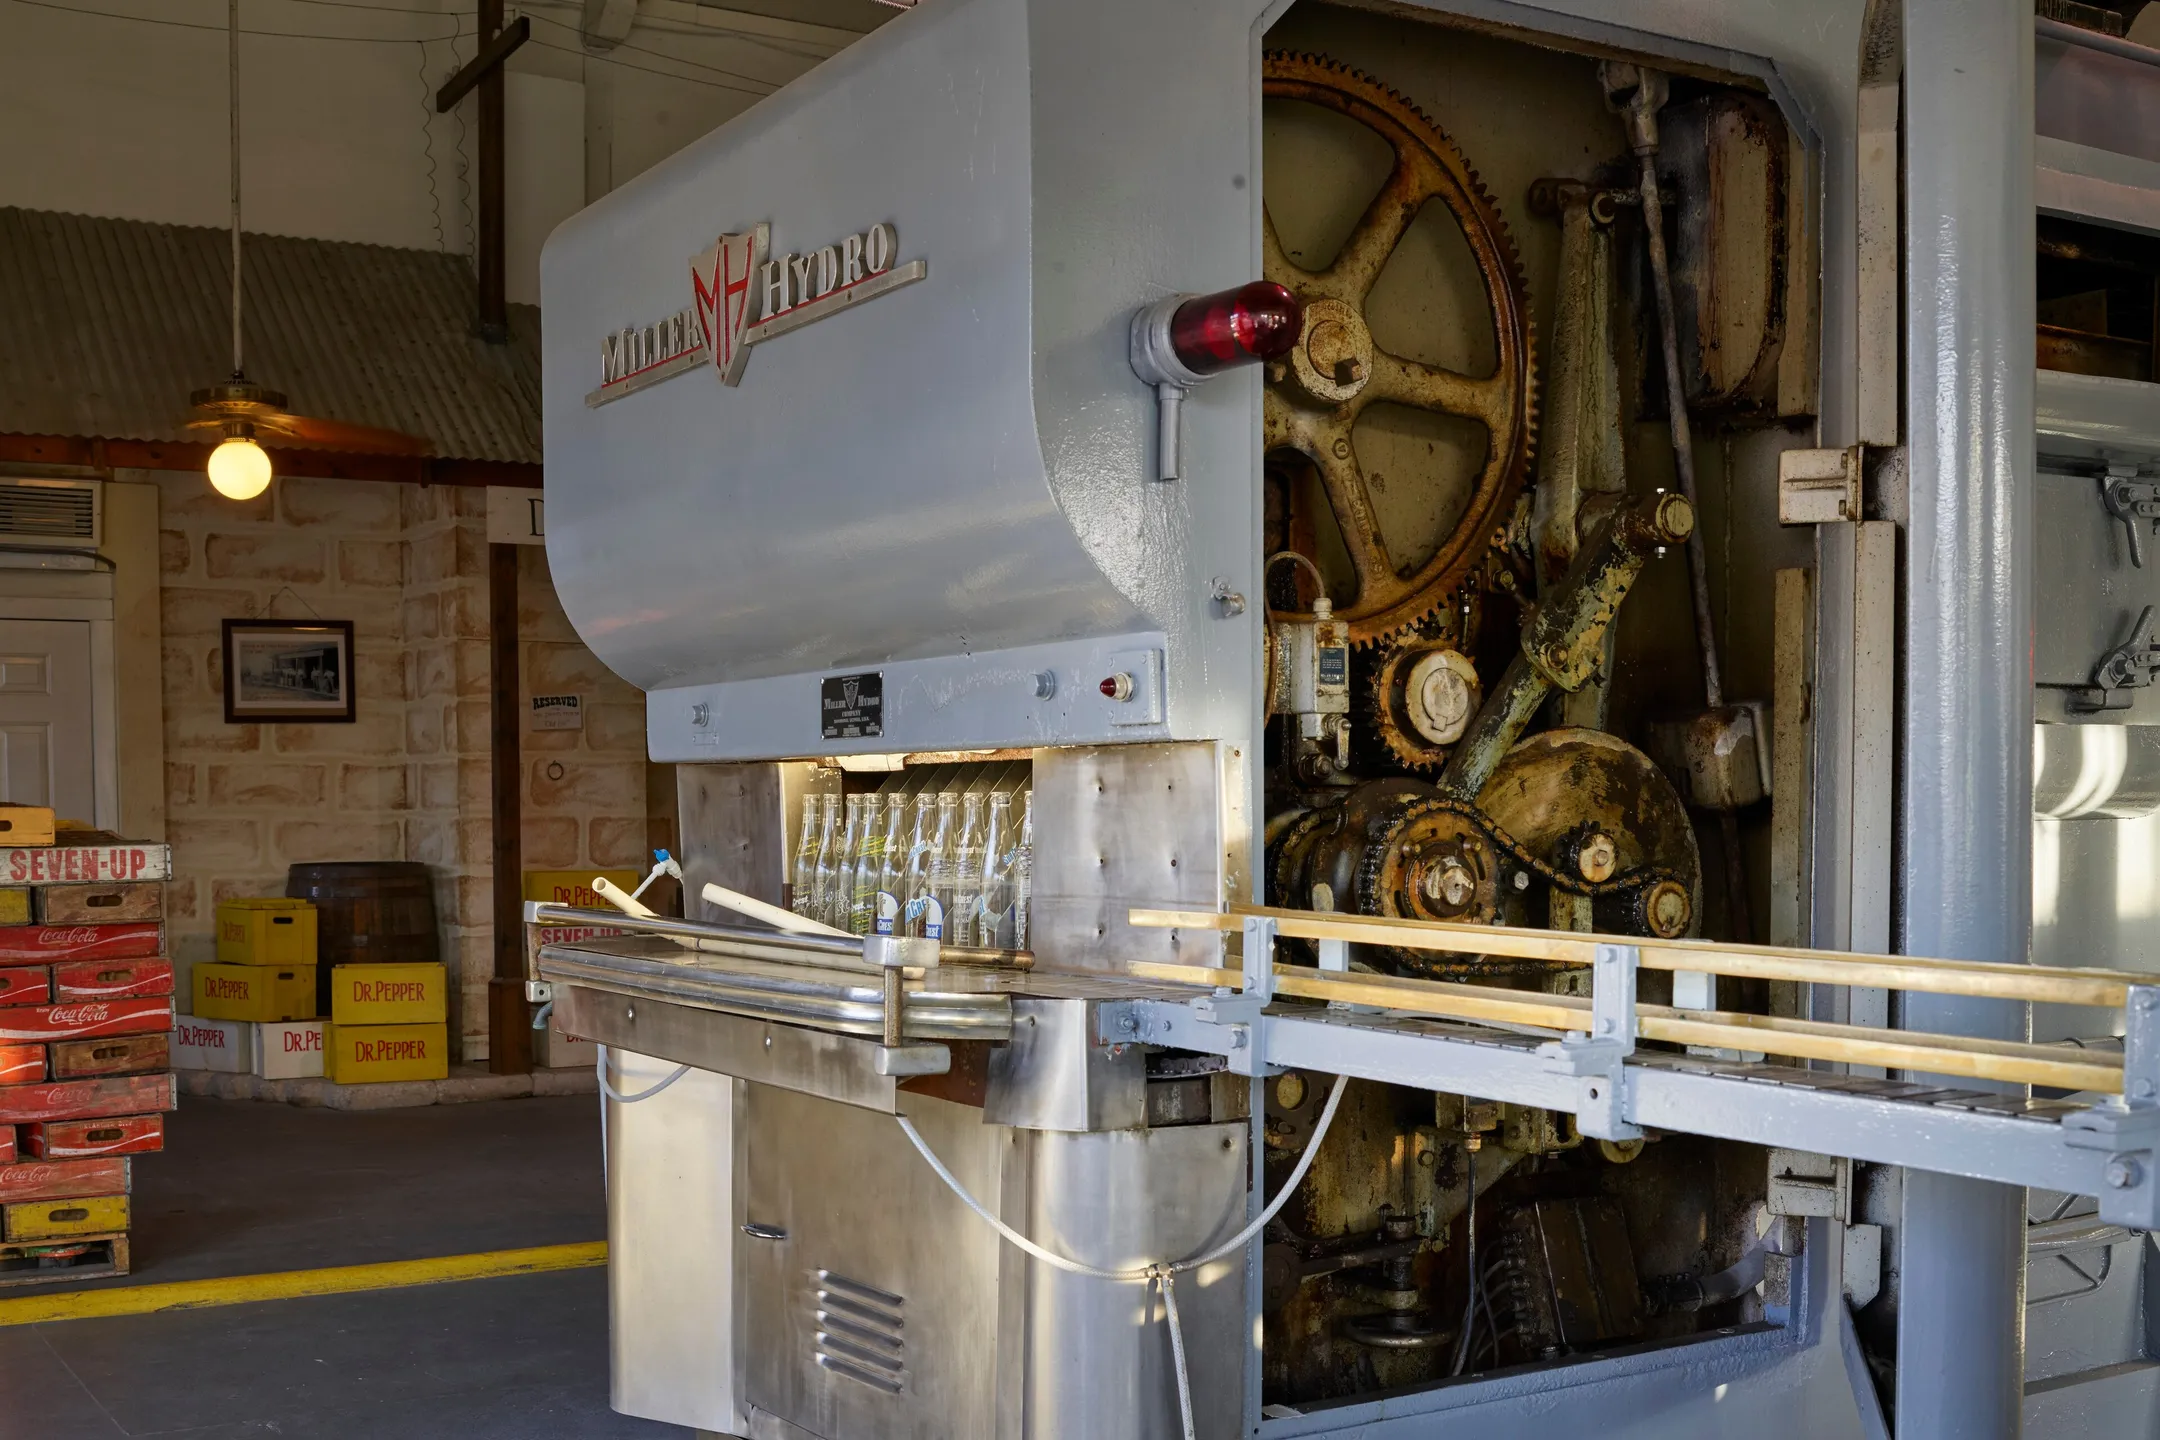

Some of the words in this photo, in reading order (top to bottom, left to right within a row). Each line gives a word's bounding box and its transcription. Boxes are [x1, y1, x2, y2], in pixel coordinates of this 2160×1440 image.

[601, 308, 701, 385] MILLER
[760, 222, 896, 319] HYDRO
[532, 695, 578, 710] RESERVED
[10, 849, 146, 881] SEVEN-UP
[38, 926, 98, 945] Coca-Cola
[48, 1003, 110, 1024] Coca-Cola
